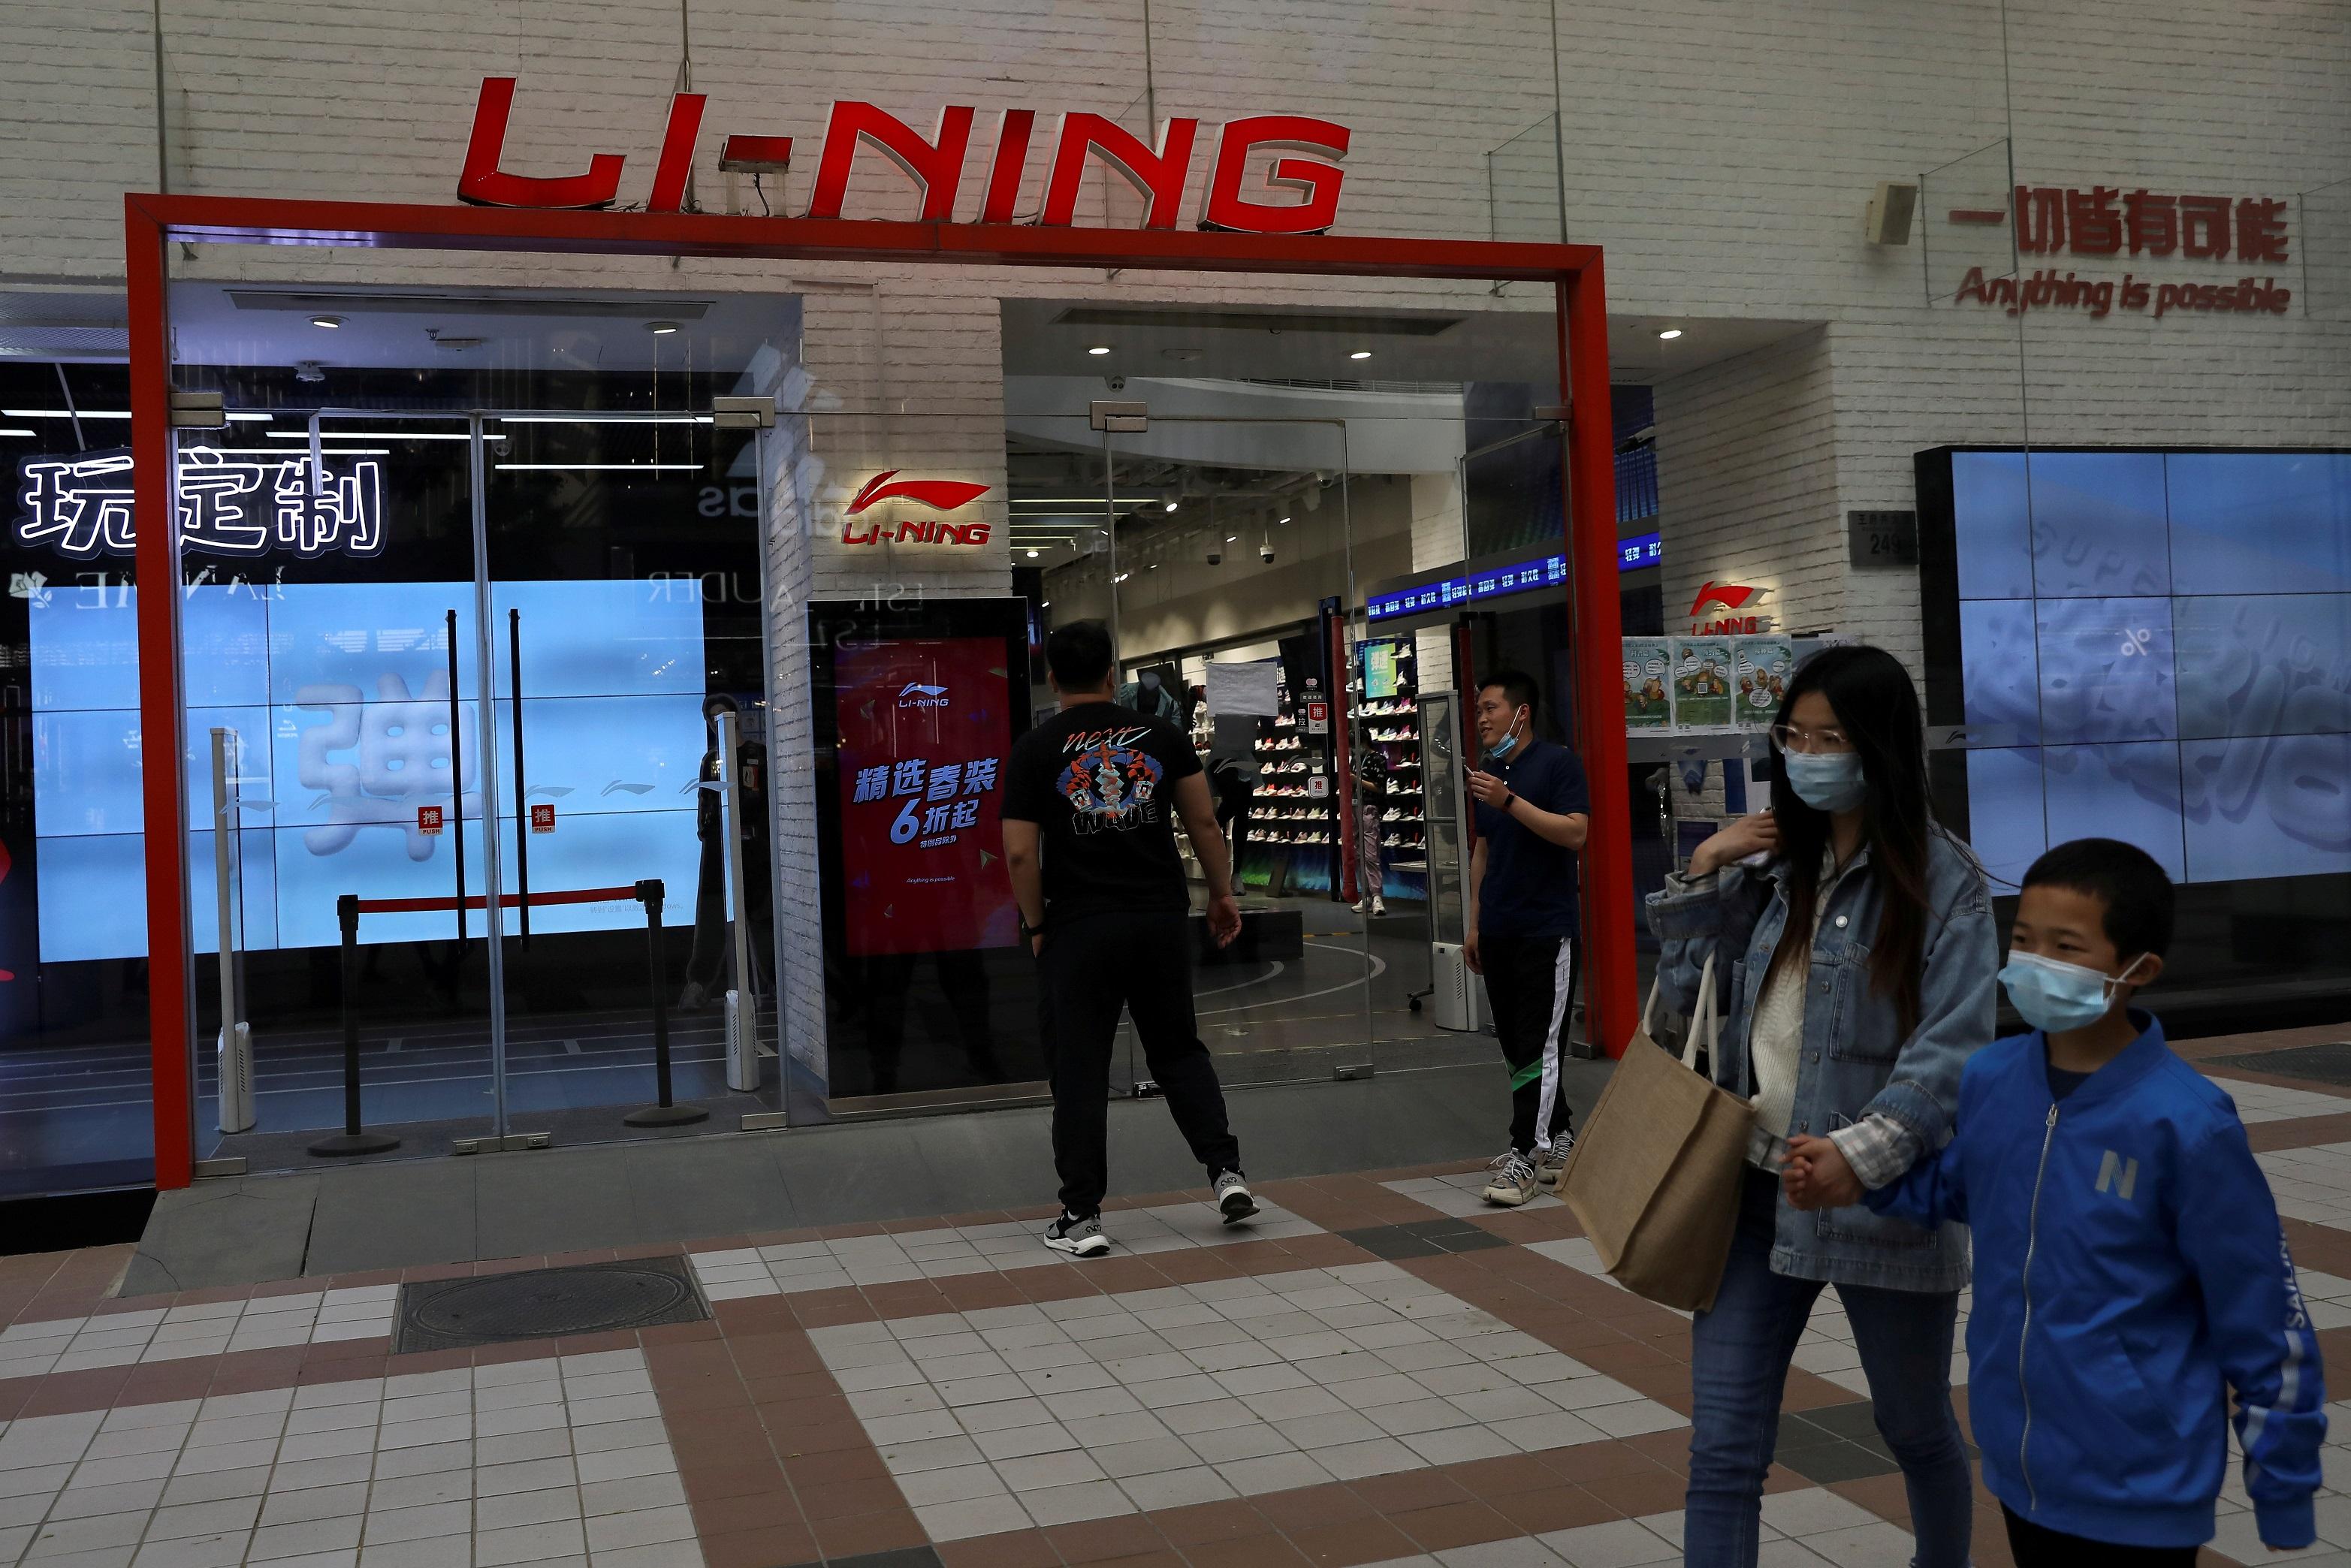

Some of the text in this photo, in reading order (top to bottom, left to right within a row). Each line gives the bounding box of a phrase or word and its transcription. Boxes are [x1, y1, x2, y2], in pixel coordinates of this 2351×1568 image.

[457, 77, 1352, 235] LI-NING
[1948, 185, 2289, 262] 一切皆有可能
[1954, 267, 2292, 319] Anything is possible
[20, 445, 382, 551] 玩定制
[841, 520, 991, 547] LI-NING
[899, 698, 949, 707] LI-NING
[1298, 717, 1305, 725] 拉
[1313, 707, 1323, 718] 推
[853, 757, 999, 804] 精选春装
[422, 810, 439, 825] 推
[535, 808, 551, 822] 推
[889, 798, 979, 844] 6折起
[2094, 1150, 2138, 1201] N
